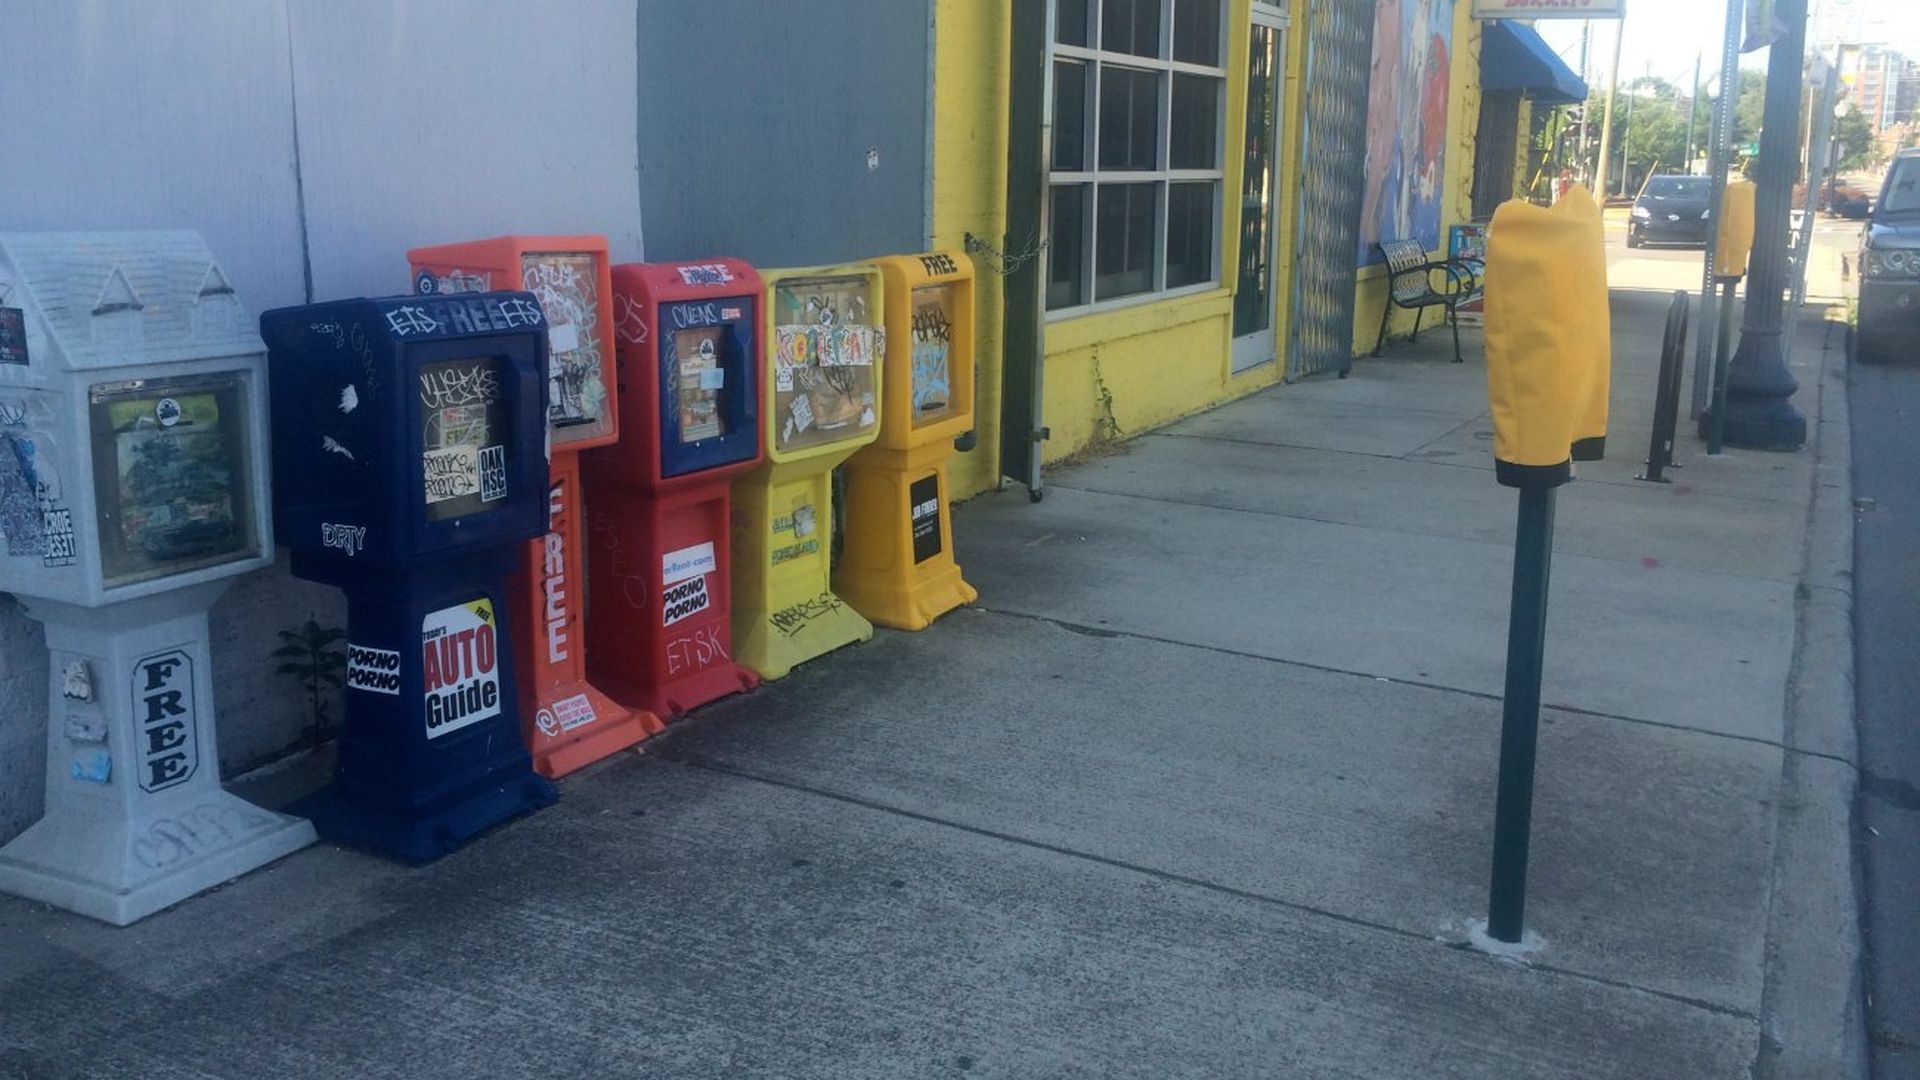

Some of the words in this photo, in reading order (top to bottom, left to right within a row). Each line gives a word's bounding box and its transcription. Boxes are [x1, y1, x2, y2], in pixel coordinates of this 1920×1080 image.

[919, 253, 957, 276] FREE
[430, 298, 506, 334] FREE
[480, 447, 502, 472] OAK
[482, 469, 505, 493] HSC
[663, 577, 704, 606] PORNO
[475, 606, 490, 622] FREE
[664, 592, 706, 624] PORNO
[349, 648, 399, 671] PORNO
[424, 623, 495, 693] AUTO
[349, 667, 400, 690] PORNO
[426, 679, 497, 729] Guide
[144, 657, 188, 787] FREE
